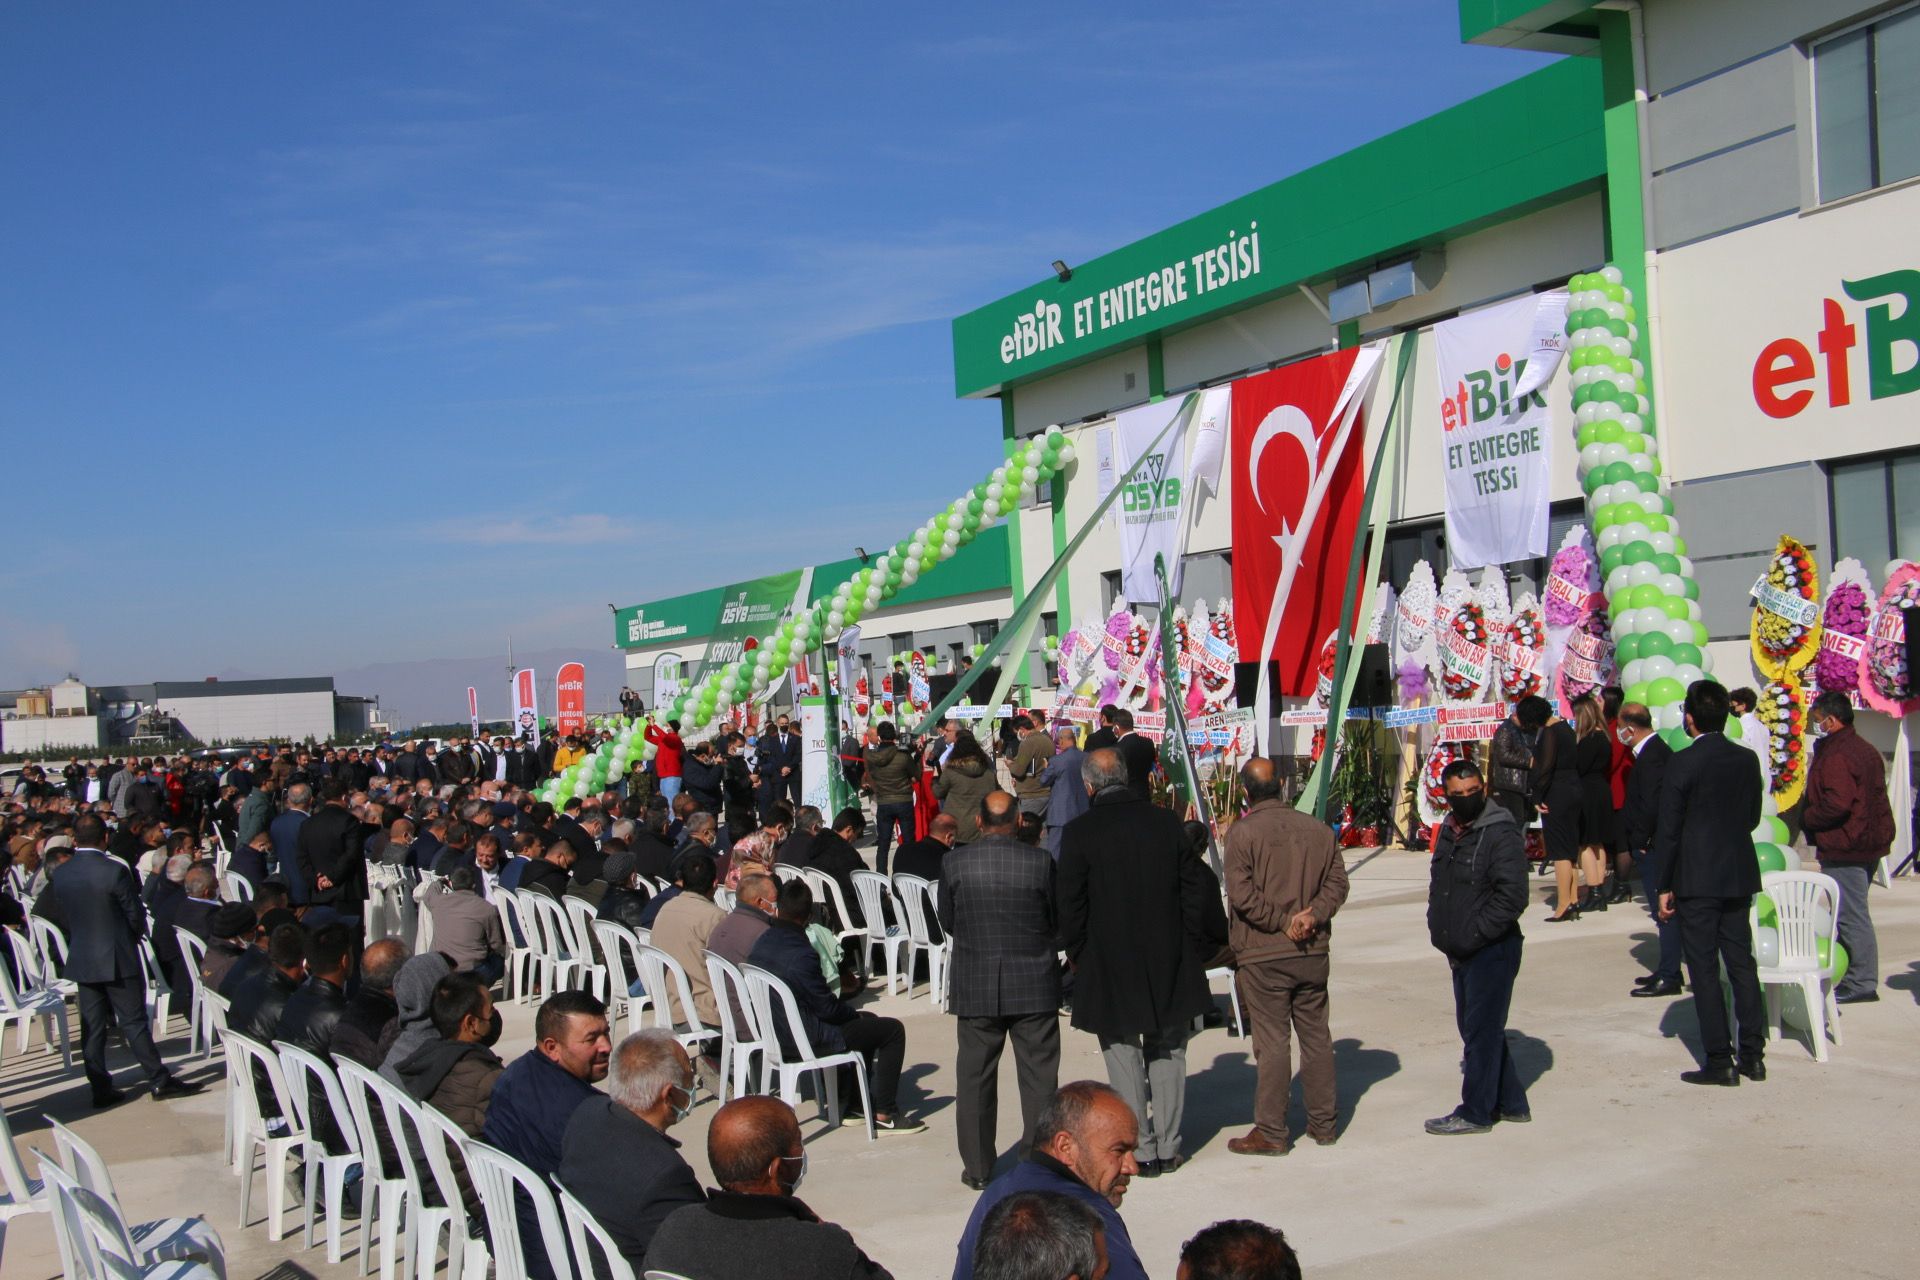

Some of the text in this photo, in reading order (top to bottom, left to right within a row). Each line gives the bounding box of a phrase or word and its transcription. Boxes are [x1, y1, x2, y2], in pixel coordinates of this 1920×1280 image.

[1073, 296, 1094, 339] ET
[1099, 260, 1188, 330] ENTEGRE
[1540, 338, 1561, 348] TKDK
[1448, 426, 1541, 470] ET ENTEGRE
[1204, 714, 1225, 729] AREN
